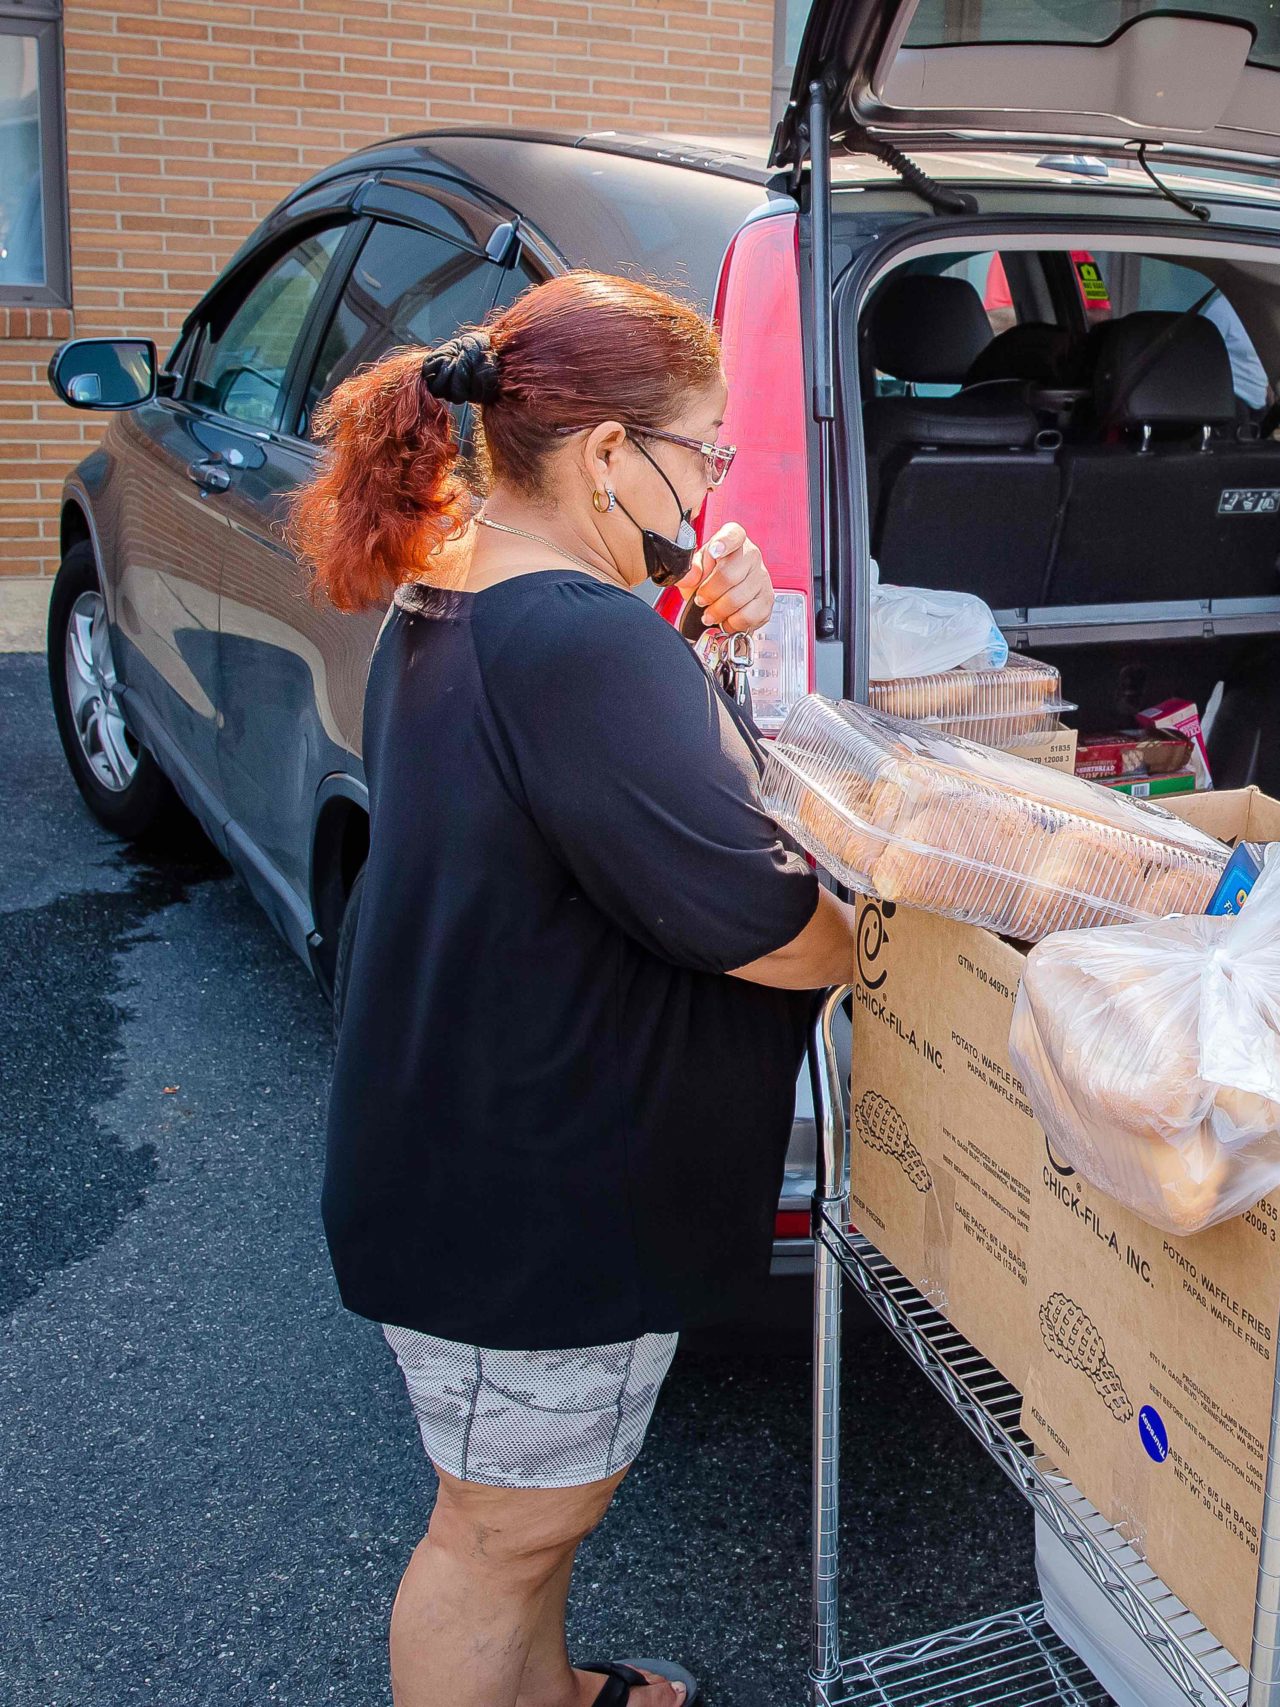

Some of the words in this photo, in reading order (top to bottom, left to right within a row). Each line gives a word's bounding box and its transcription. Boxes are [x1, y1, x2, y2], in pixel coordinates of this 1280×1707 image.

[958, 954, 974, 974] GTIN
[976, 967, 988, 983] 100
[988, 978, 1009, 999] 44979
[856, 983, 920, 1054] CHICK-FIL-A,
[923, 1040, 946, 1074] INC.
[951, 1031, 980, 1062] POTATO,
[981, 1054, 1011, 1085] WAFFLE
[967, 1061, 988, 1086] PAPAS,
[989, 1079, 1013, 1104] WAFFLE
[1015, 1098, 1034, 1119] FRIES
[955, 1202, 970, 1223] CASE
[971, 1216, 988, 1239] PACK:
[1008, 1248, 1028, 1274] BAGS,
[964, 1221, 975, 1240] NET
[1043, 1166, 1122, 1260] CHICK-FIL-A,
[1126, 1246, 1154, 1288] INC.
[1270, 1229, 1276, 1242] 3
[1163, 1240, 1198, 1282] POTATO,
[1200, 1274, 1238, 1316] WAFFLE
[1242, 1309, 1271, 1341] FRIES
[1182, 1279, 1209, 1311] PAPAS,
[1210, 1303, 1242, 1339] WAFFLE
[1244, 1334, 1270, 1360] FRIES
[1031, 1406, 1046, 1430] KEEP
[1046, 1425, 1070, 1456] FROZEN
[1140, 1412, 1166, 1460] Thursday
[1150, 1383, 1162, 1401] BEST
[1163, 1395, 1184, 1421] BEFORE
[1184, 1414, 1198, 1435] DATE
[1198, 1428, 1206, 1443] OR
[1207, 1436, 1244, 1479] PRODUCTION
[1245, 1471, 1262, 1496] DATE
[1168, 1369, 1183, 1388] GAGE
[1200, 1400, 1236, 1438] KENNEWICK,
[1236, 1432, 1246, 1448] WA
[1182, 1373, 1211, 1404] PRODUCED
[1212, 1399, 1220, 1413] BY
[1220, 1407, 1237, 1428] LAMB
[1238, 1422, 1265, 1453] WESTON
[1168, 1446, 1183, 1467] ASE
[1184, 1462, 1206, 1491] PACK:
[1208, 1486, 1218, 1502] 6/5
[1220, 1498, 1232, 1514] LB
[1234, 1509, 1259, 1542] BAGS,
[1174, 1466, 1188, 1486] NET
[1190, 1482, 1201, 1499] WT
[1202, 1495, 1211, 1510] 30
[1213, 1505, 1224, 1522] LB
[1226, 1517, 1244, 1540] (13.6
[1246, 1537, 1258, 1556] kg)
